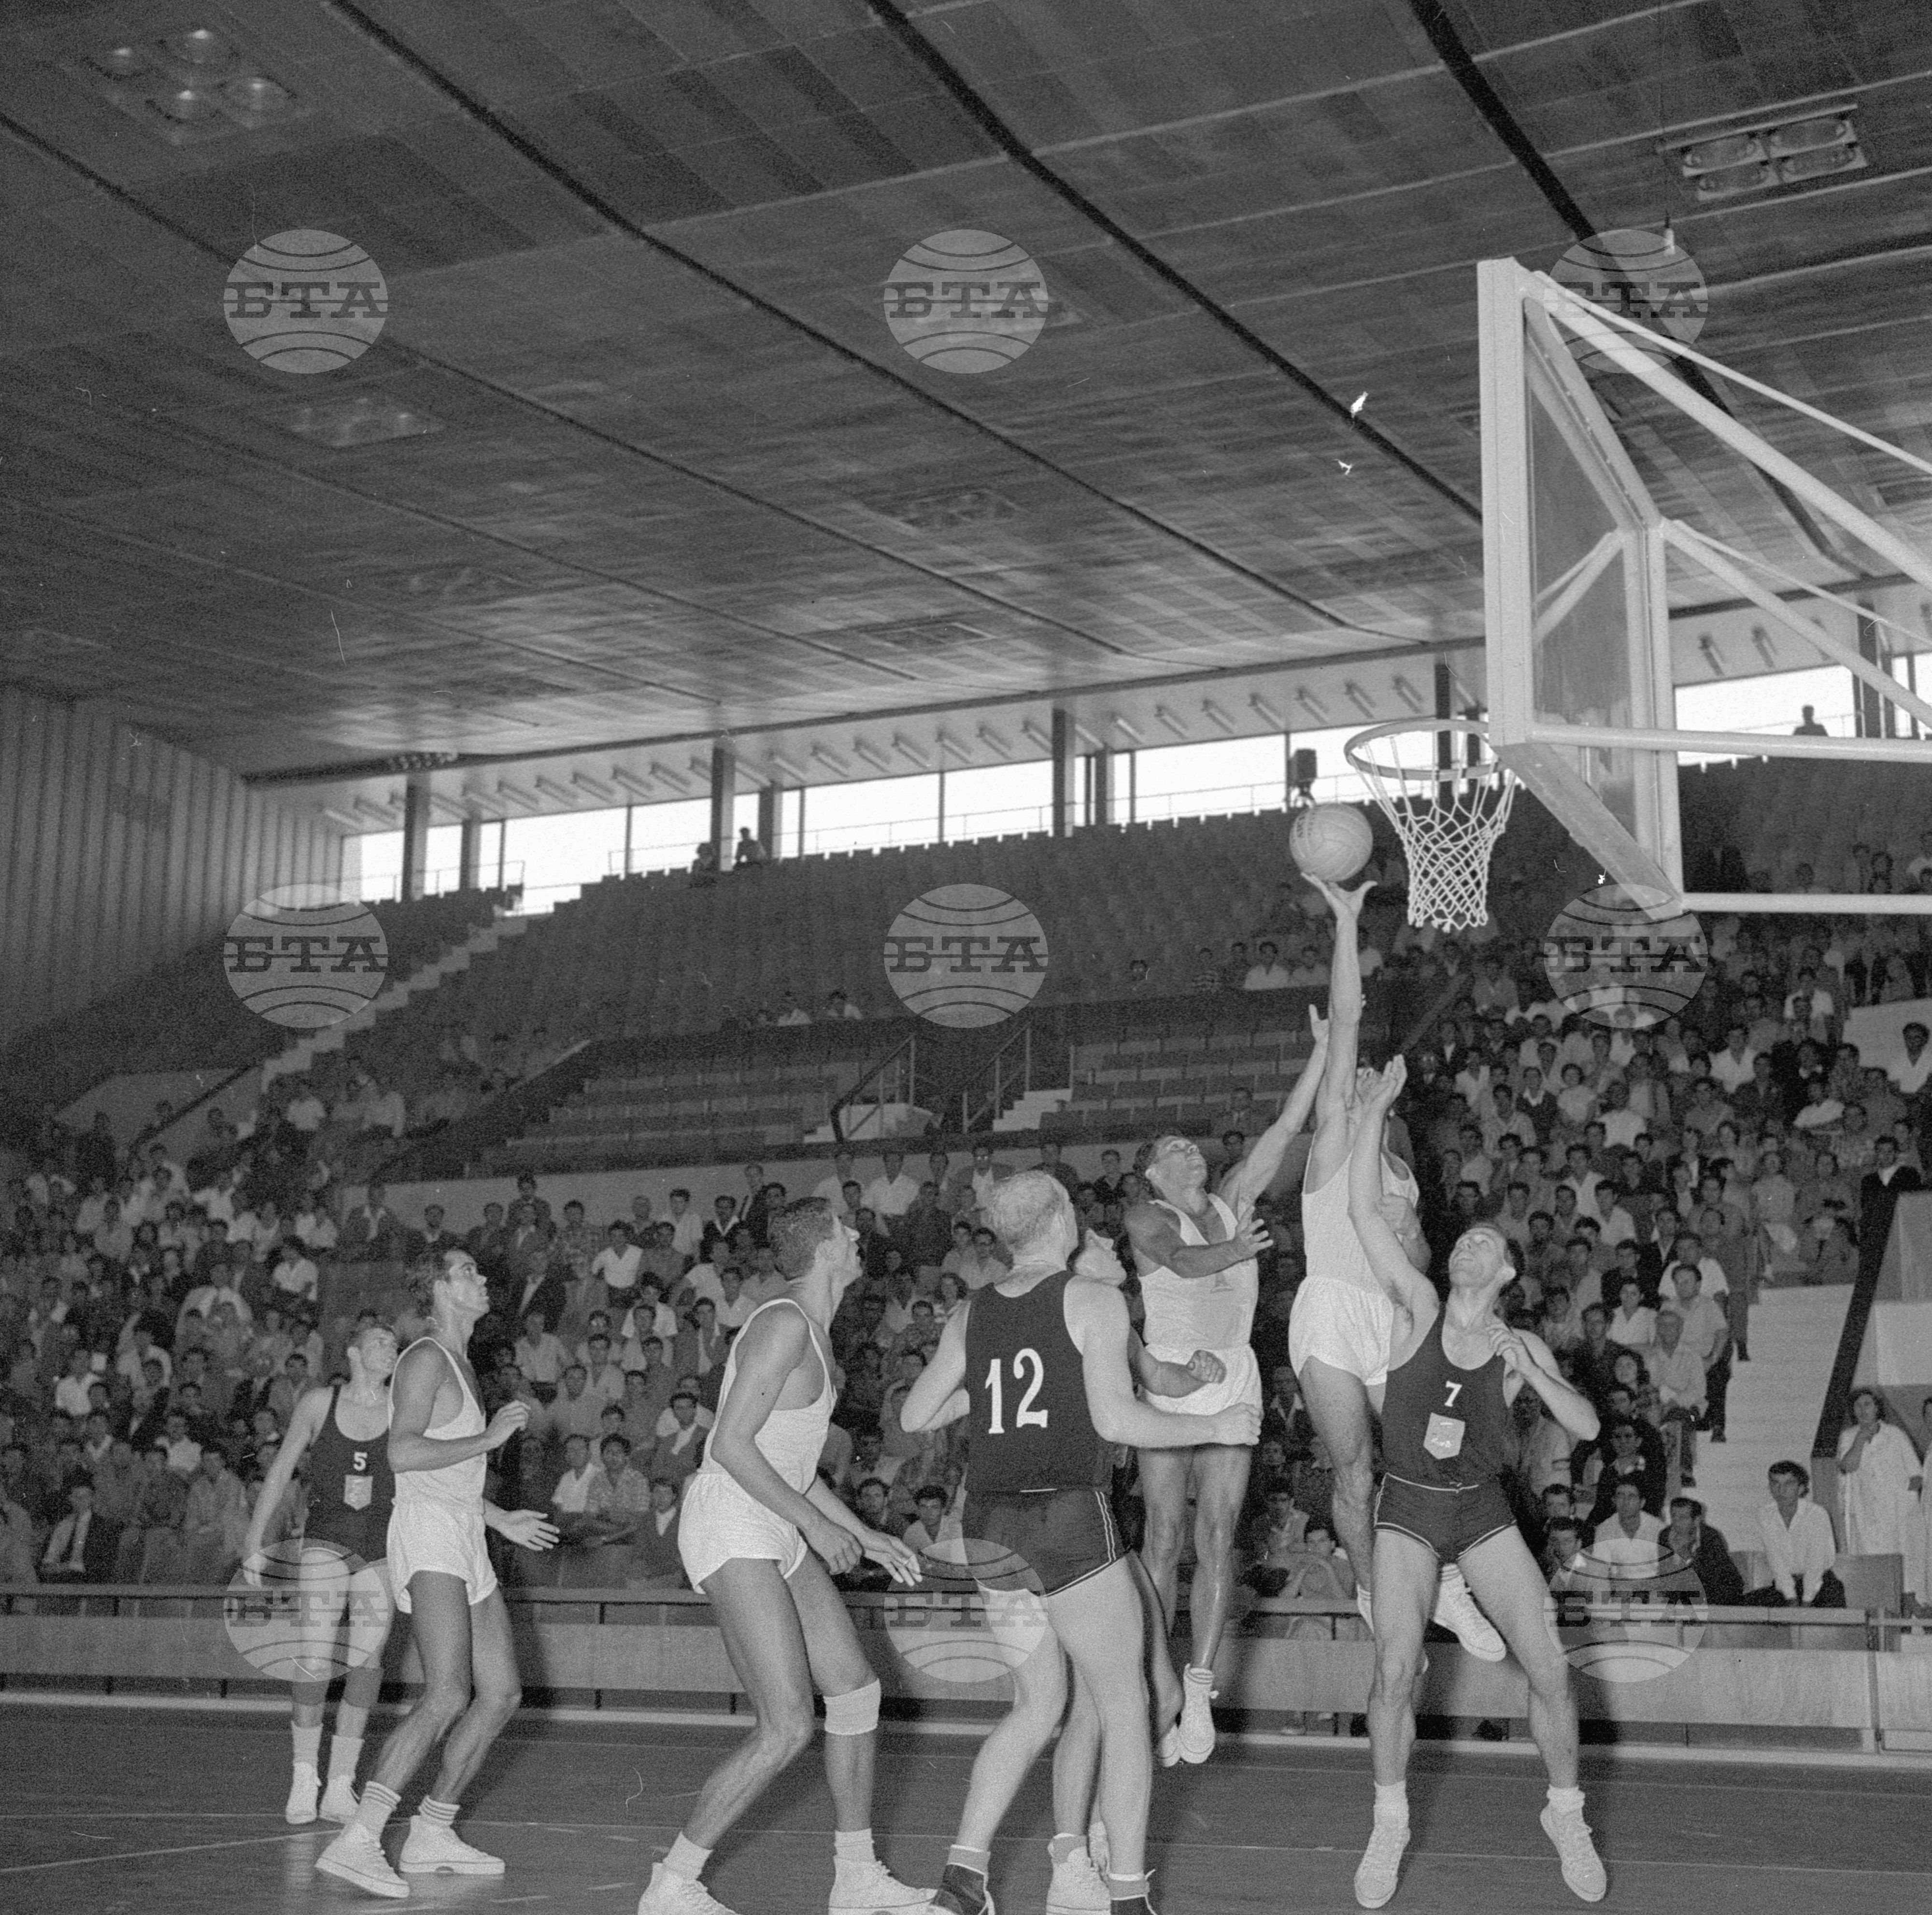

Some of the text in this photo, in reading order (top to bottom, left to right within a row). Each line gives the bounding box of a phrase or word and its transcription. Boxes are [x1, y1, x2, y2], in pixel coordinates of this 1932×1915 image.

[984, 1348, 1049, 1434] 12
[1445, 1381, 1462, 1407] 7
[353, 1452, 368, 1471] 5
